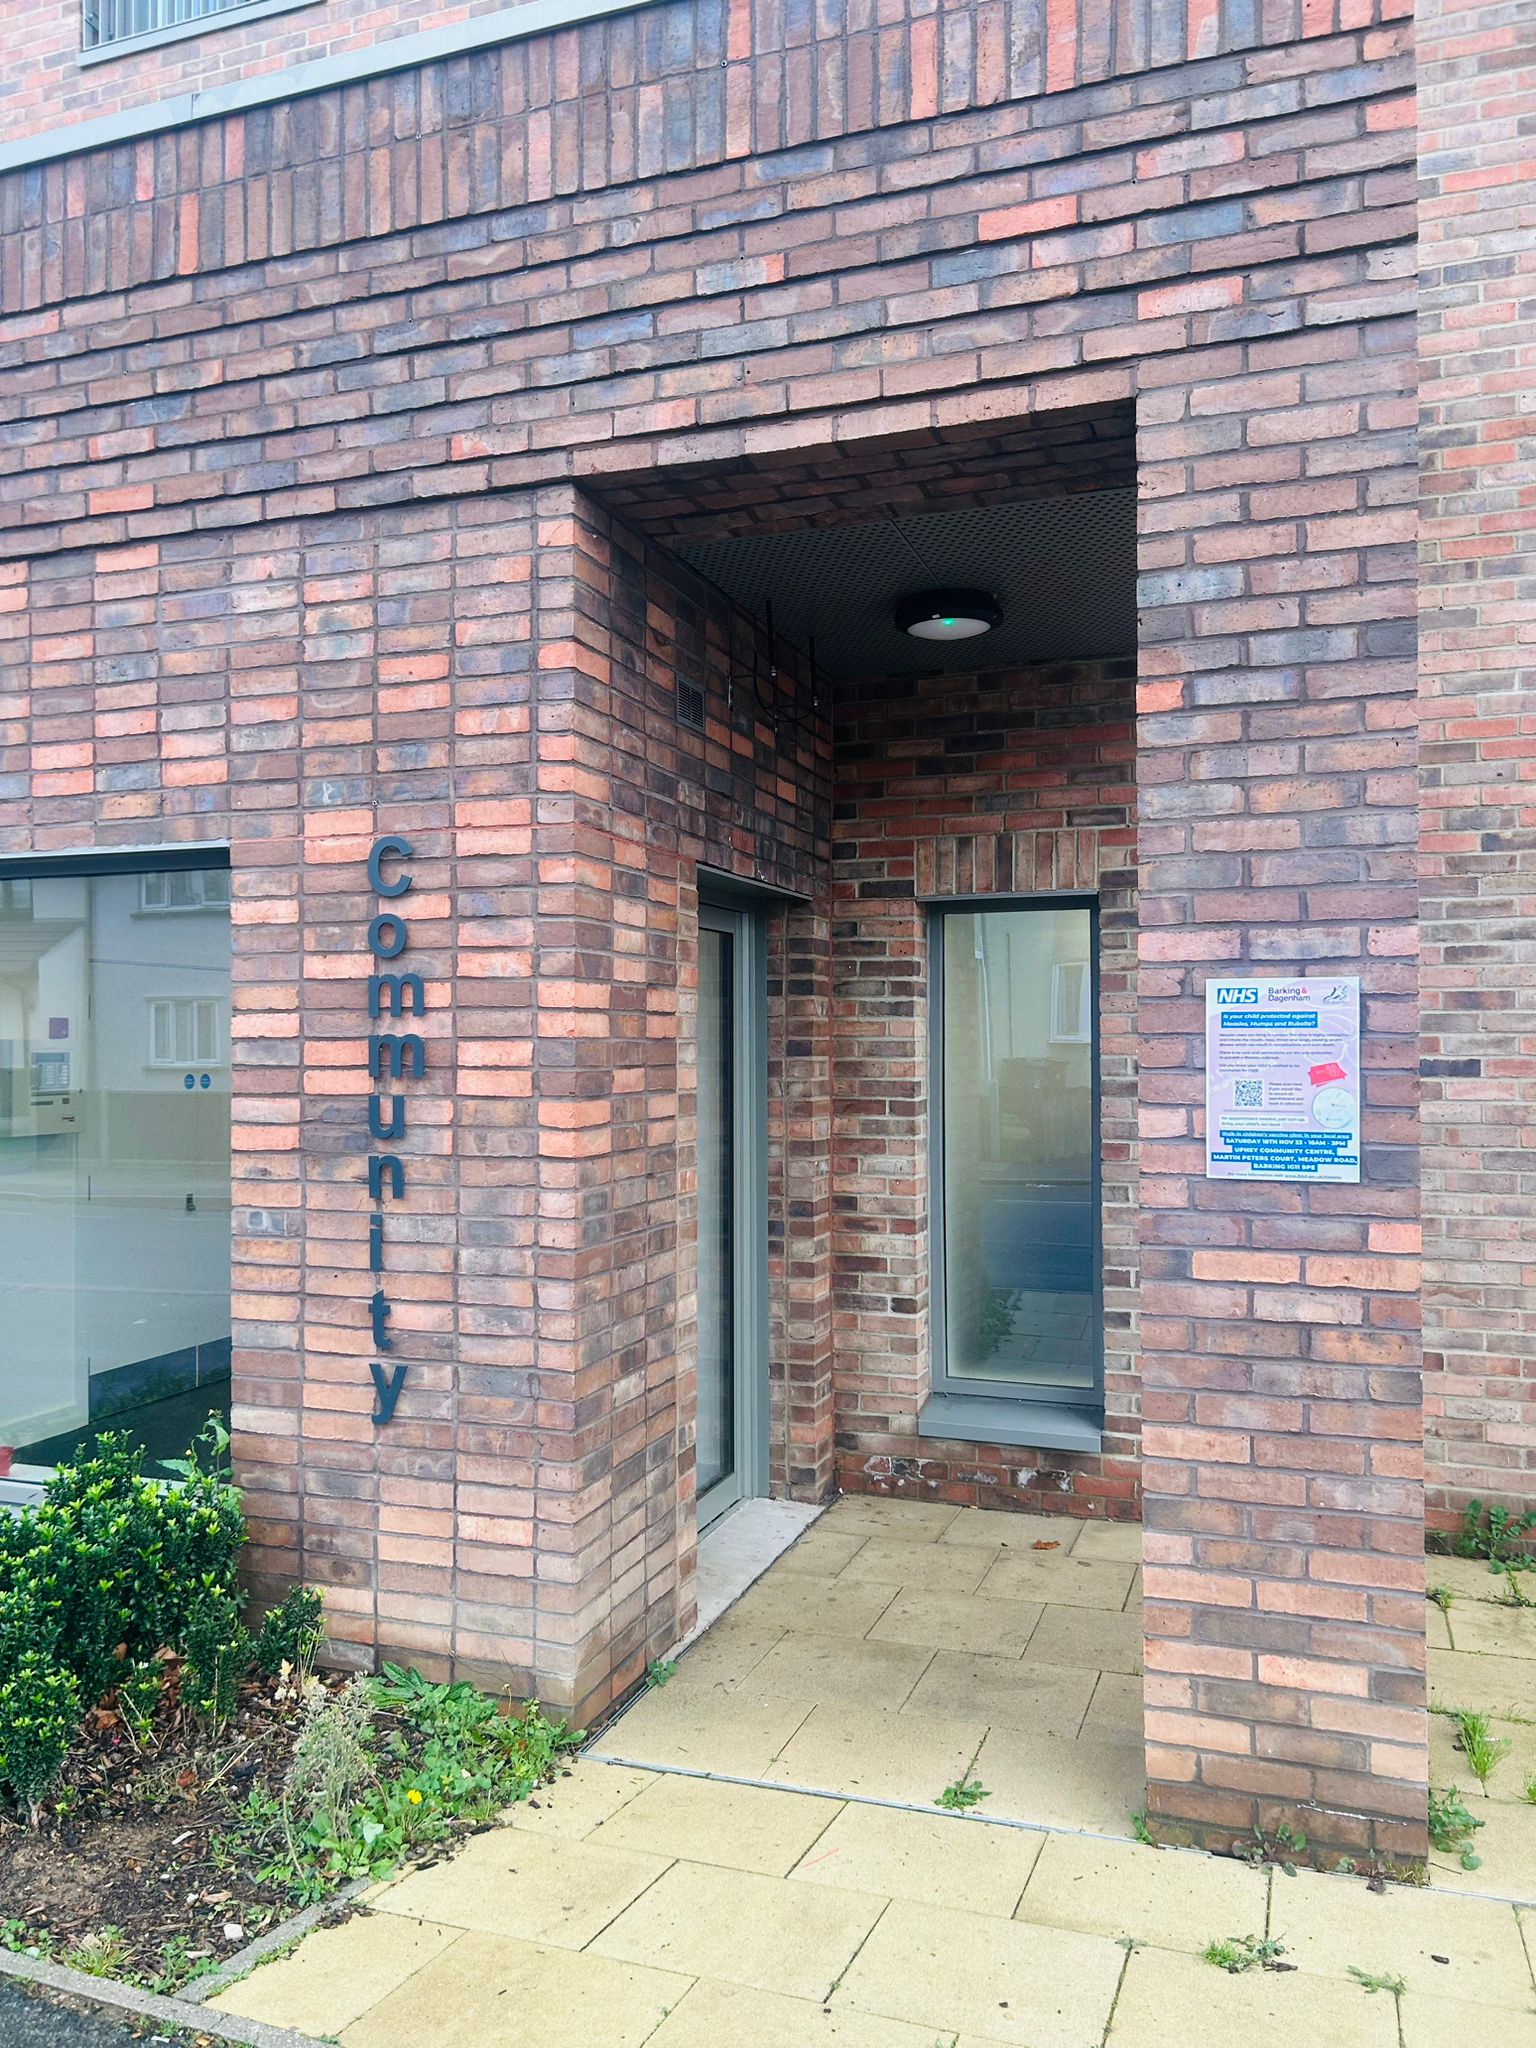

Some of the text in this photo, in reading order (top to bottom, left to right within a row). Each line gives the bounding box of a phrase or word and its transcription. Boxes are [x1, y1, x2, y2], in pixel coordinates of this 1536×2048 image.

[1218, 989, 1257, 1003] NHS
[1268, 987, 1300, 996] Barking
[1268, 995, 1311, 1003] Dagenham
[367, 835, 425, 1426] Community
